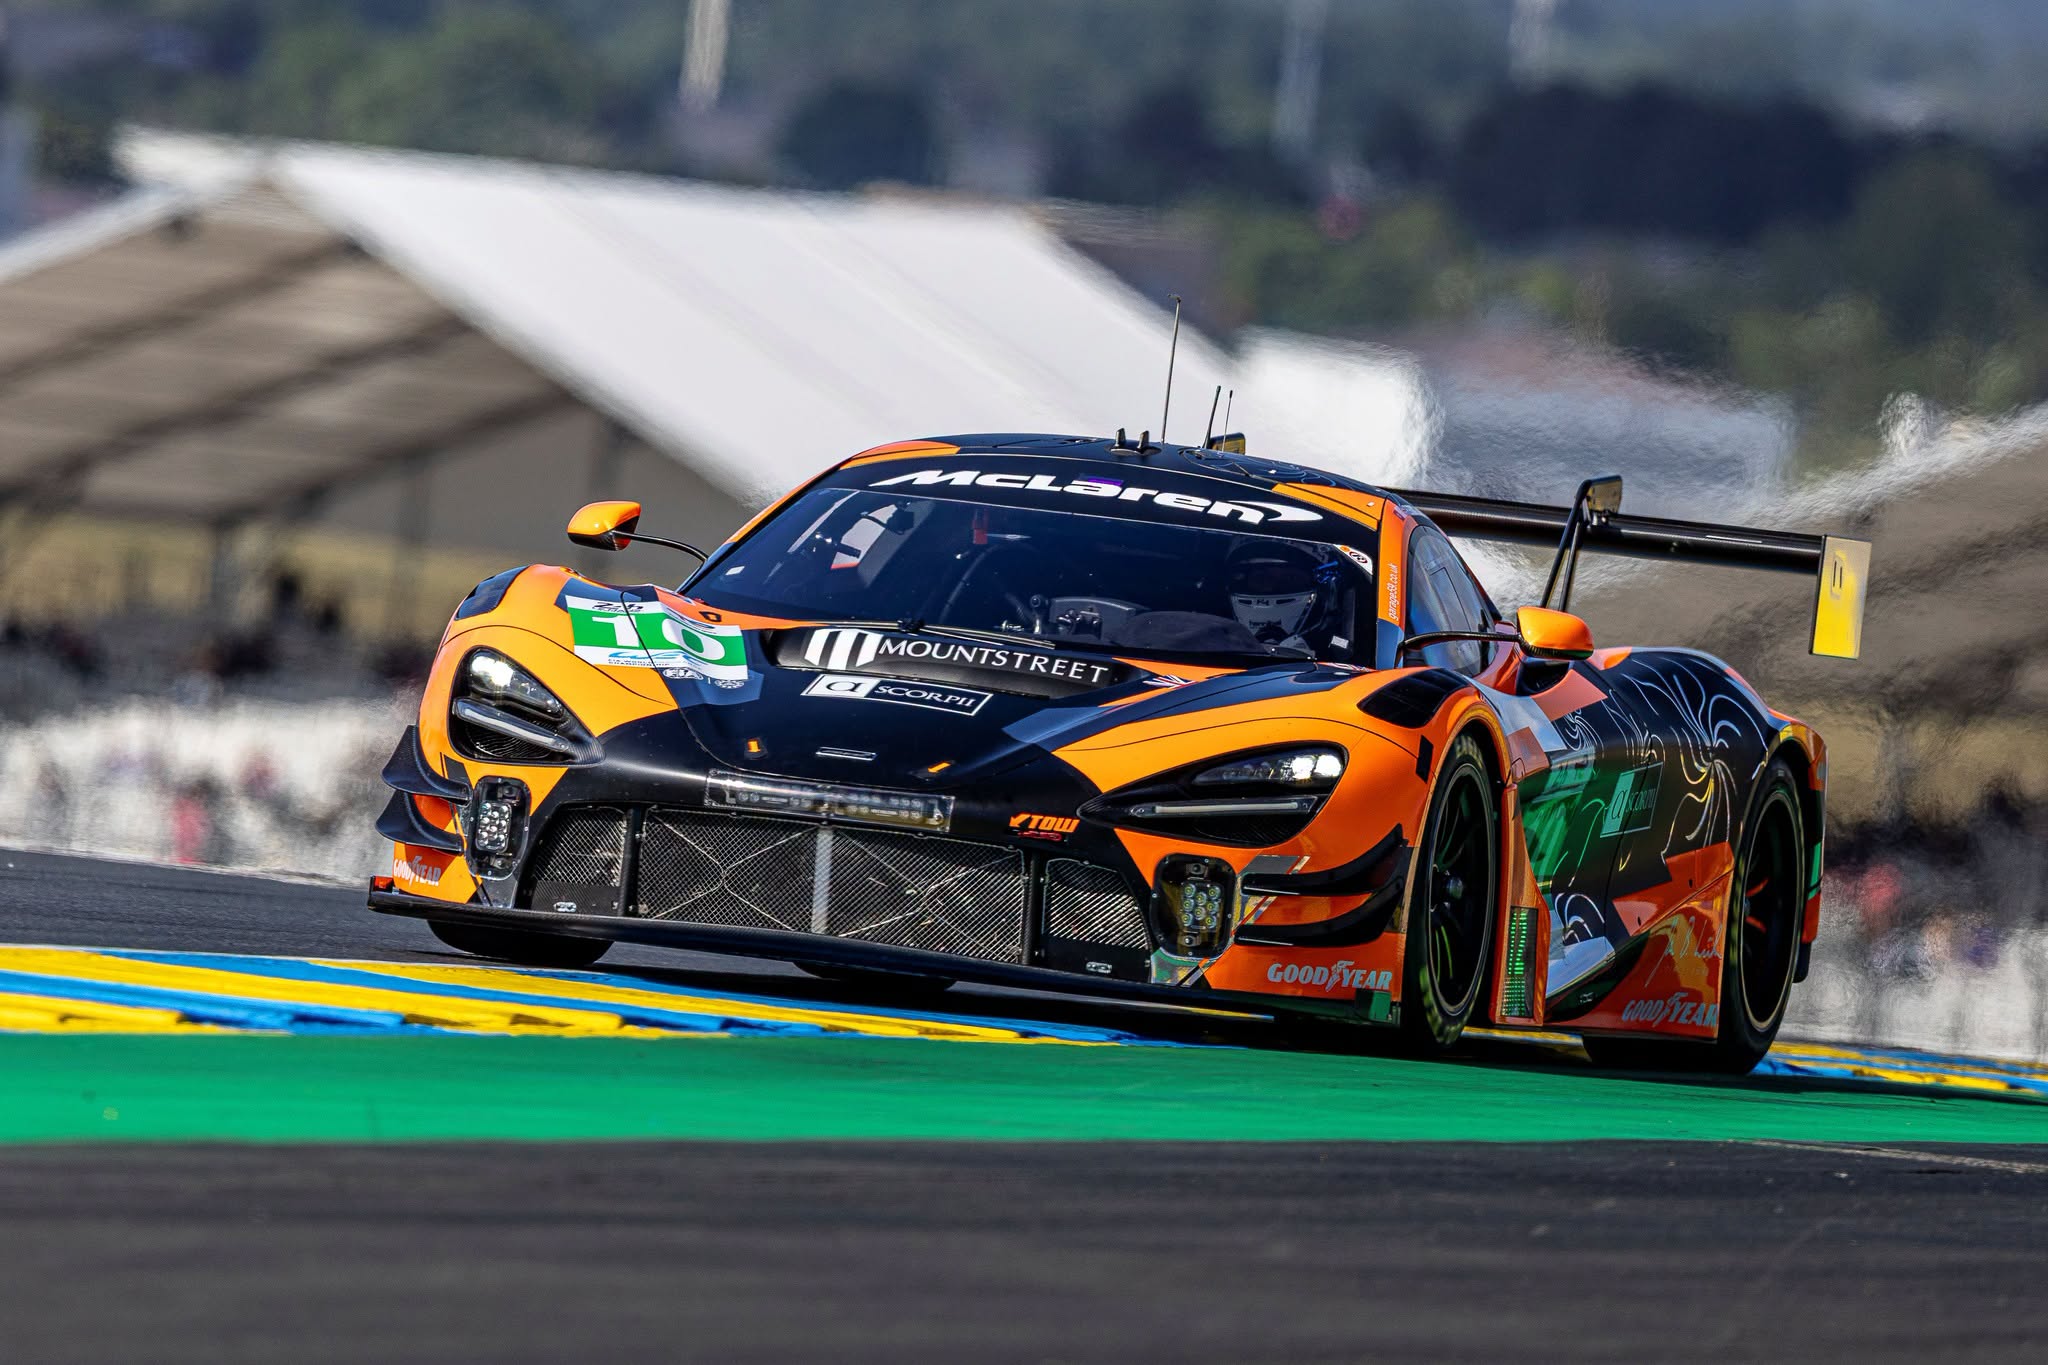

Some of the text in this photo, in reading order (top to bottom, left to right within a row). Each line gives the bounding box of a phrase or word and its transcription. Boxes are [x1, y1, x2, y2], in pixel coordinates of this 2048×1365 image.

[868, 470, 1270, 525] McLaren
[592, 615, 726, 661] 10
[878, 638, 1109, 683] MOUNTSTREET
[874, 685, 976, 706] SCORPII
[1028, 814, 1080, 833] TOW
[1267, 960, 1393, 992] GOODYEAR
[1621, 992, 1718, 1028] GOODYEAR
